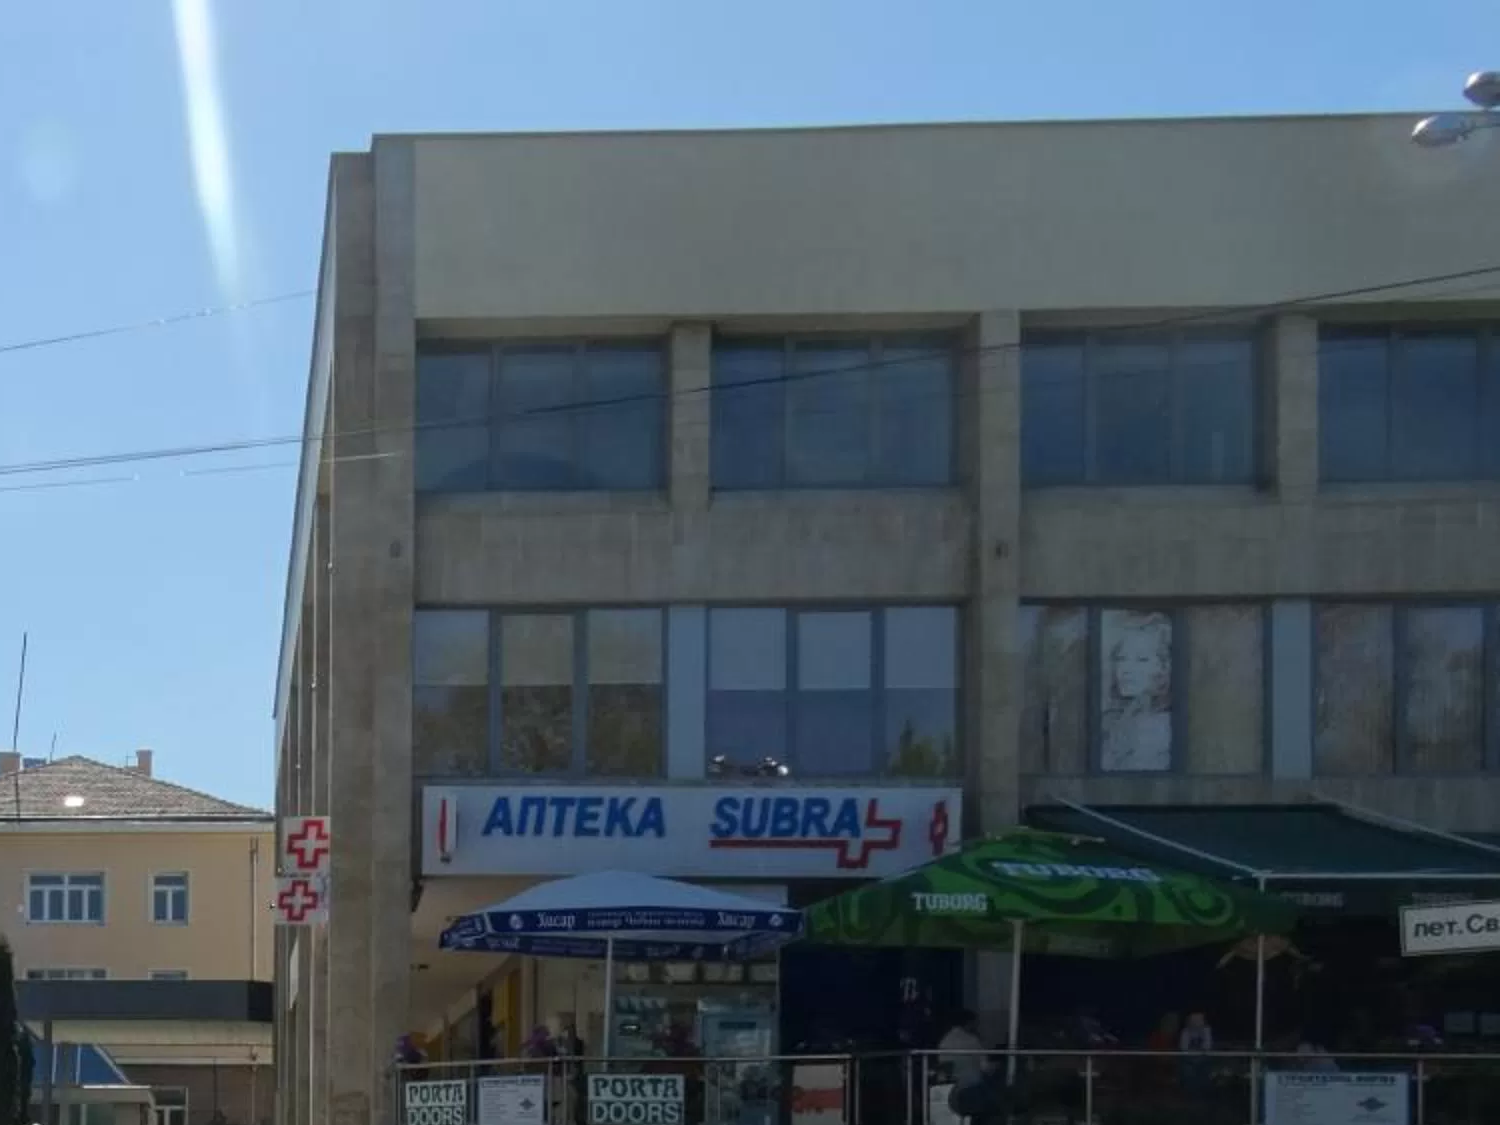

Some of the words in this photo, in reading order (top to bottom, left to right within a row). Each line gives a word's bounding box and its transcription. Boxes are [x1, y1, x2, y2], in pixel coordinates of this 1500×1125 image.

[481, 797, 667, 839] АПТЕКА
[709, 797, 862, 839] SUBRA
[989, 860, 1163, 883] TUBORG
[912, 891, 988, 913] TUBORG
[407, 1084, 465, 1105] PORTA
[592, 1076, 679, 1099] PORTA
[592, 1101, 681, 1123] DOORS
